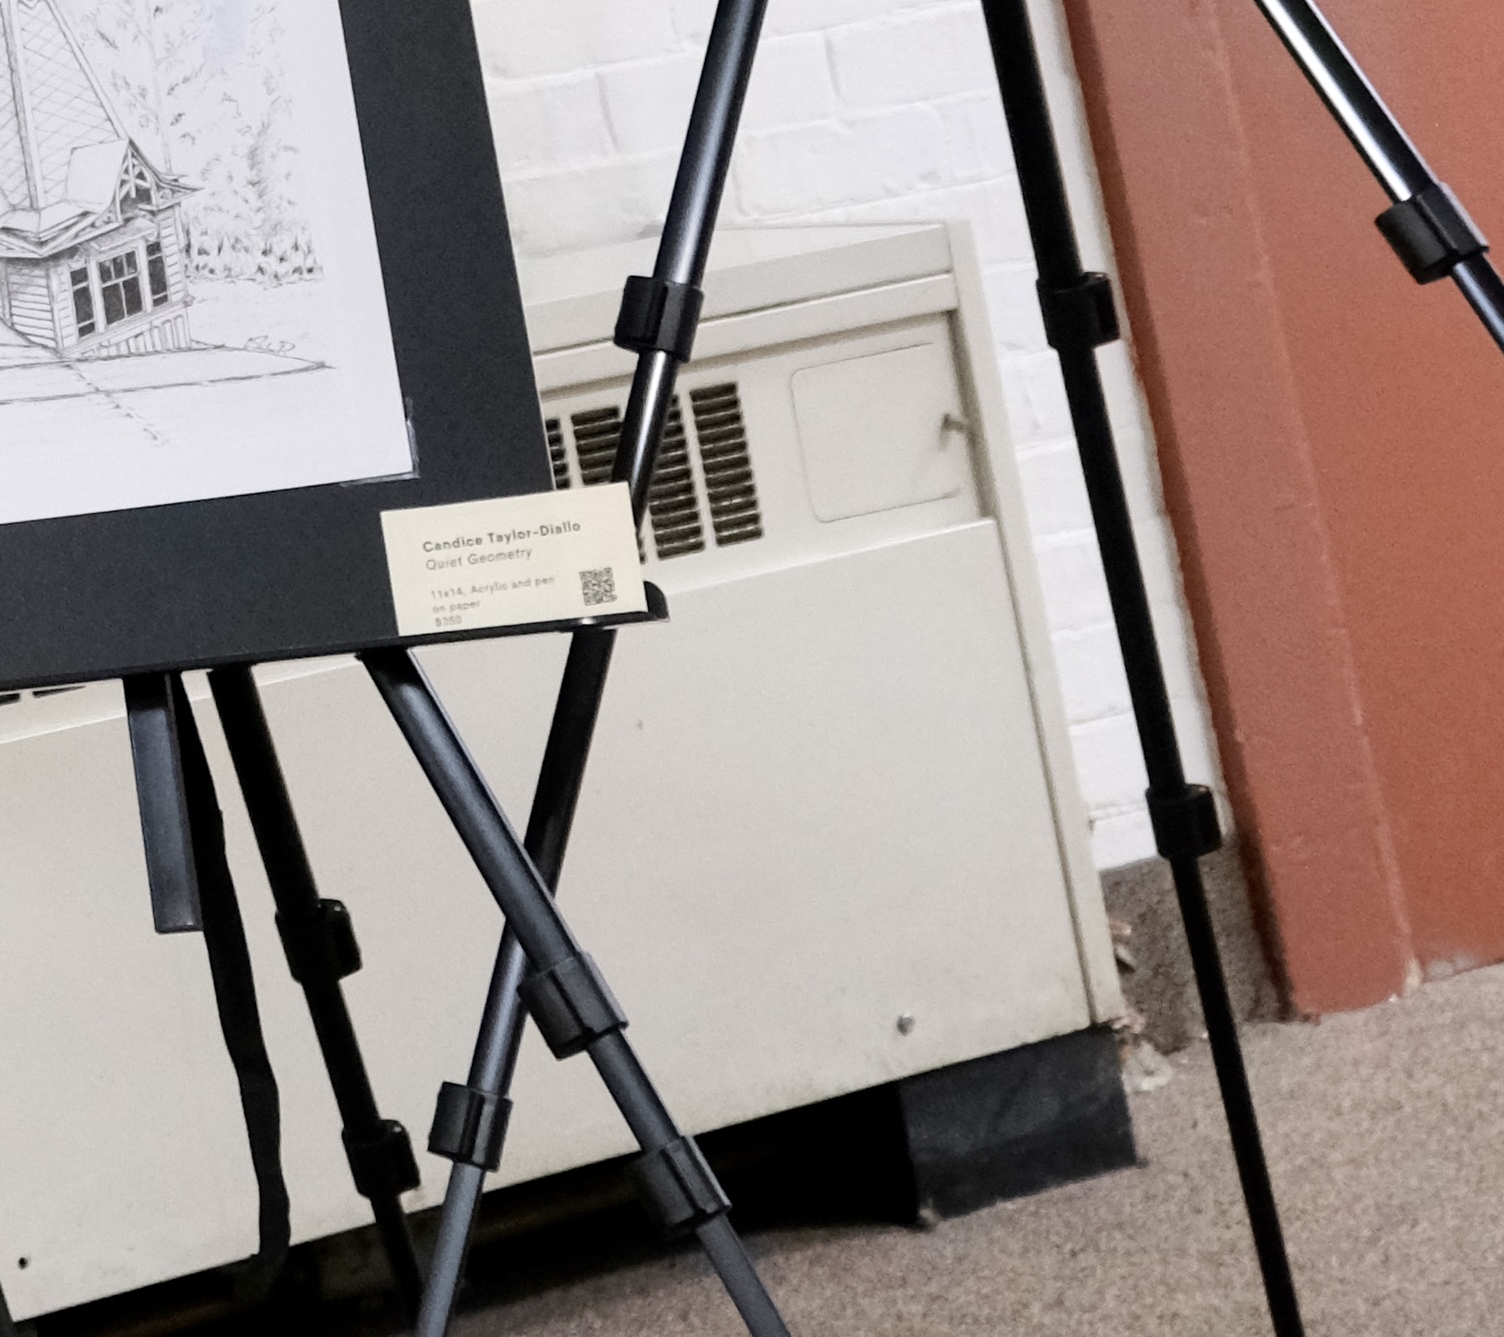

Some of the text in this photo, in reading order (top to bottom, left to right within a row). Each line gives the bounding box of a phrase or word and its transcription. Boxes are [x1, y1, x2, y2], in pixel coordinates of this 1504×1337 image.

[422, 520, 581, 553] Candice Taylor-Diallo
[425, 547, 533, 571] Quiet Geometry
[430, 576, 555, 599] 11x14, Acrylic and pen
[432, 599, 481, 614] on paper
